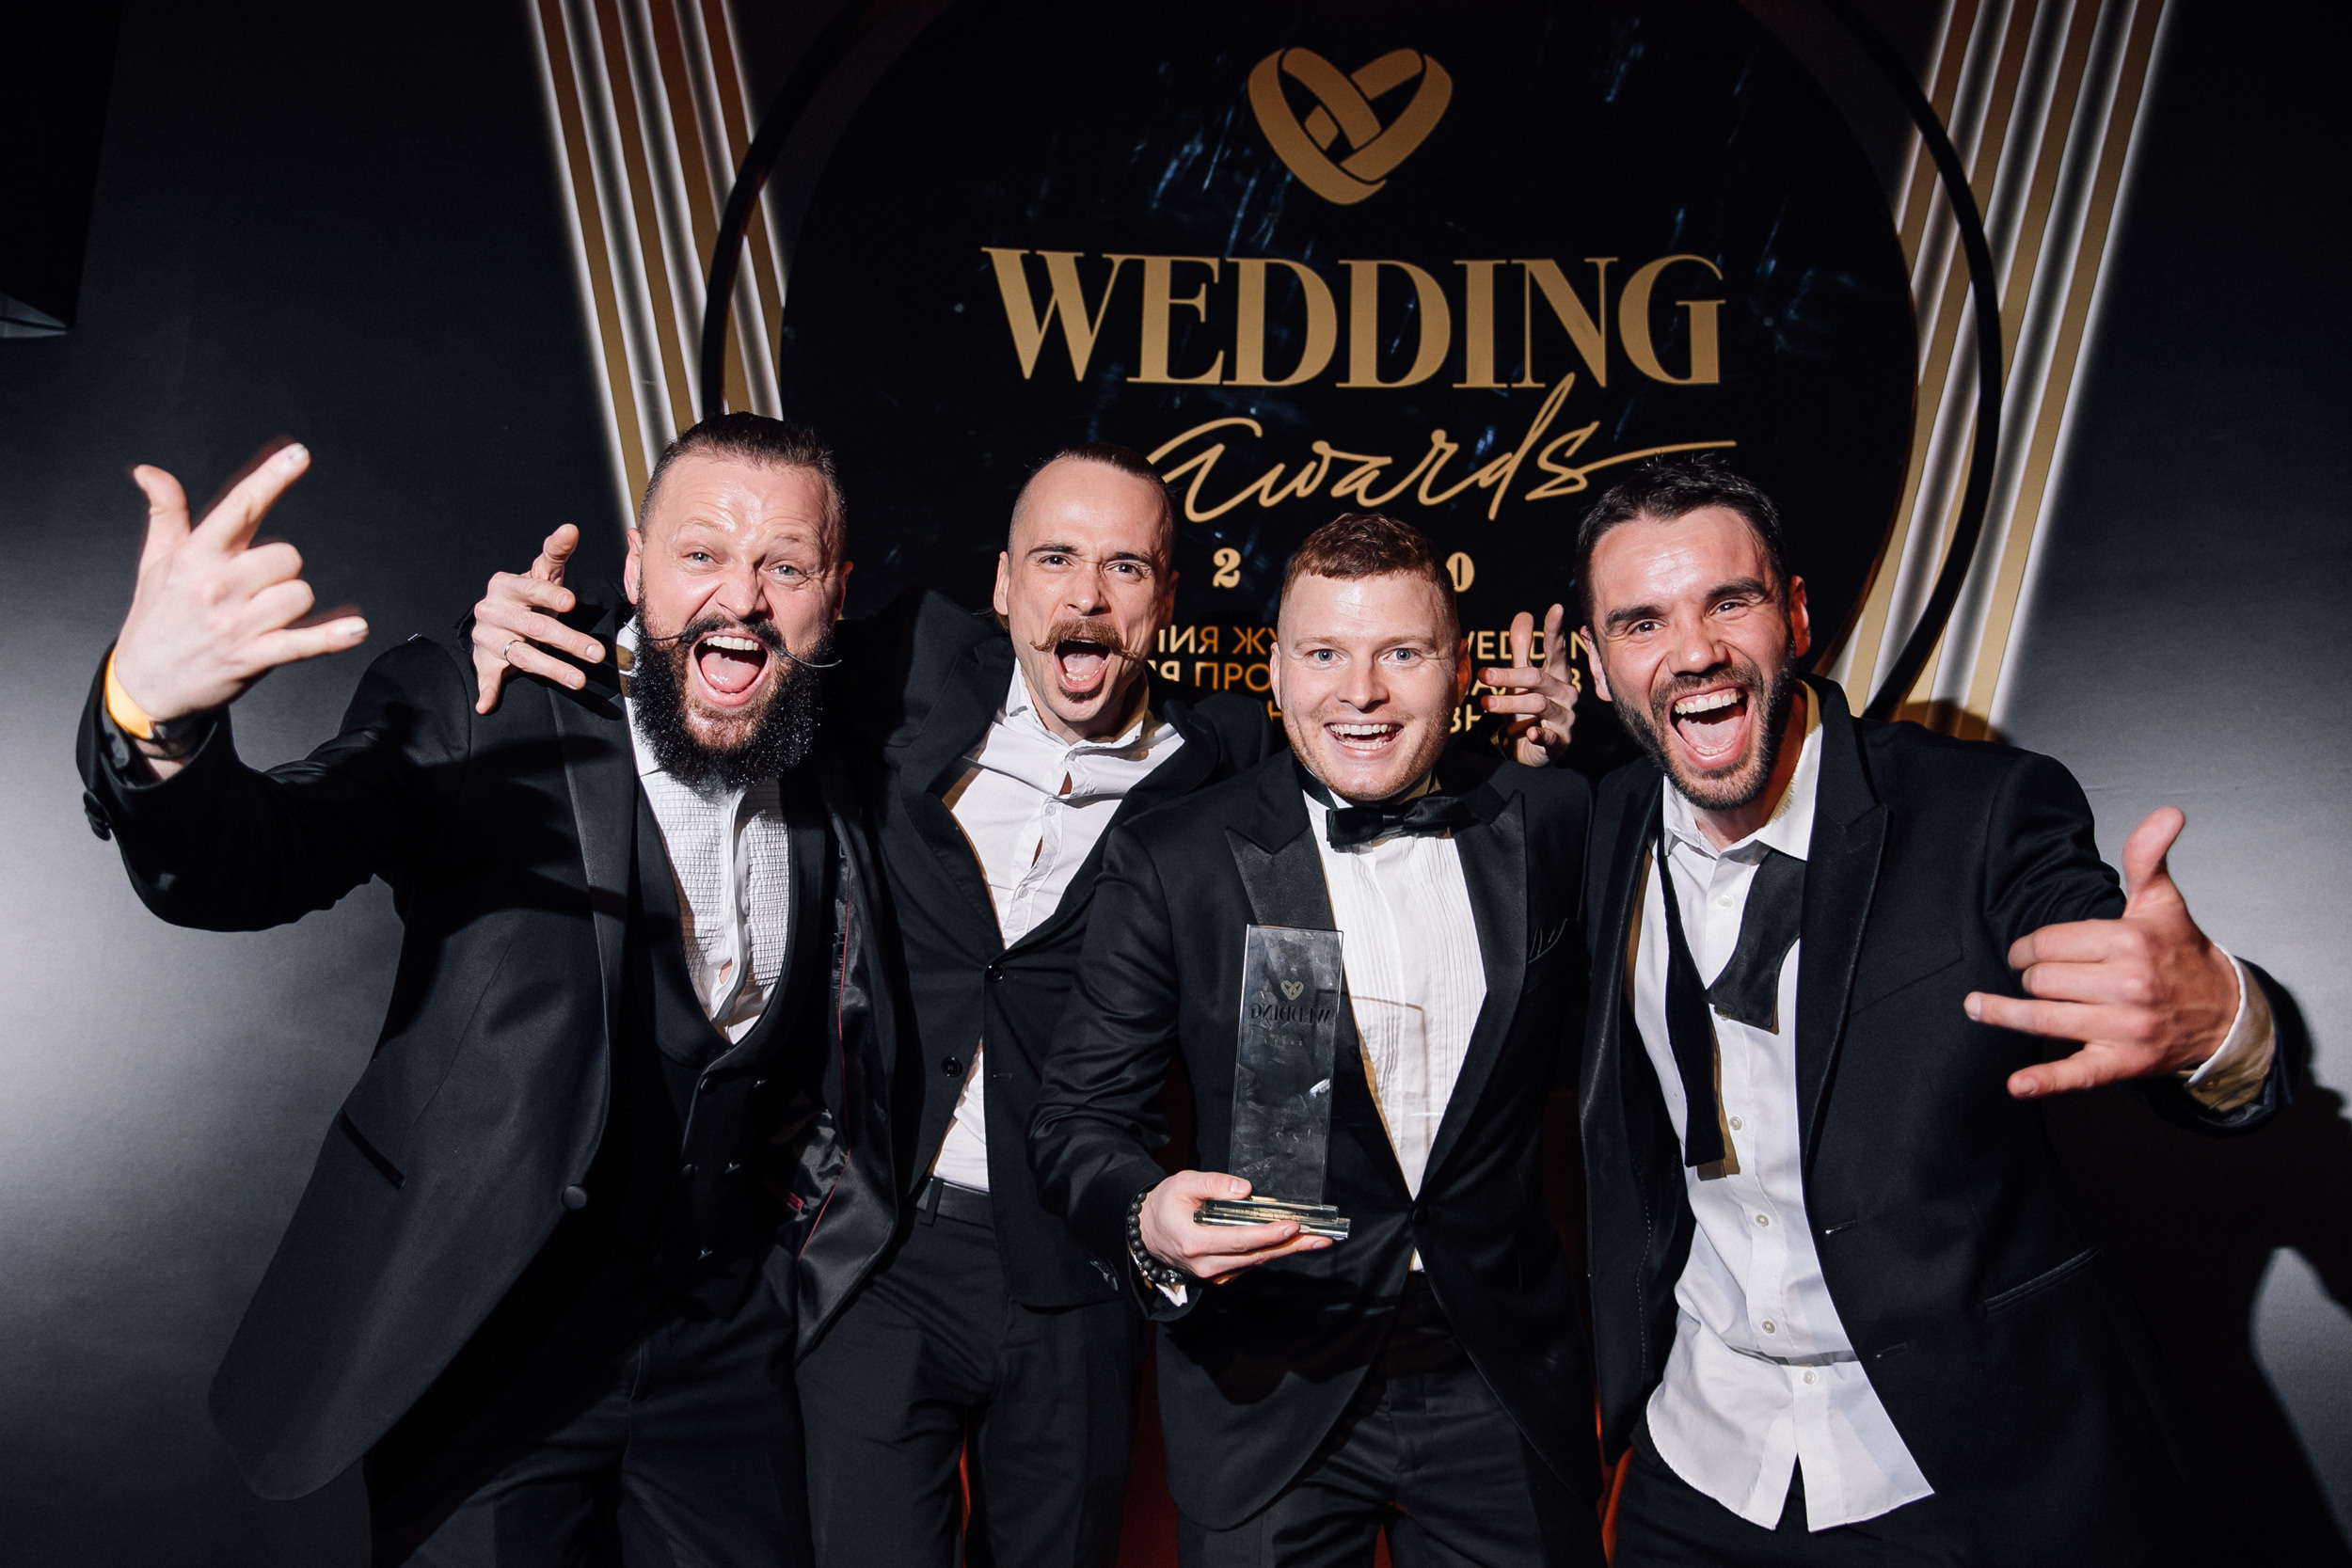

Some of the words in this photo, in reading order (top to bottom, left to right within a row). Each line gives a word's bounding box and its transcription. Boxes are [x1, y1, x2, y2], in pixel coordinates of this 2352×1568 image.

[981, 246, 1725, 388] WEDDING
[1147, 373, 1736, 523] awards
[1158, 625, 1219, 655] ИЯ
